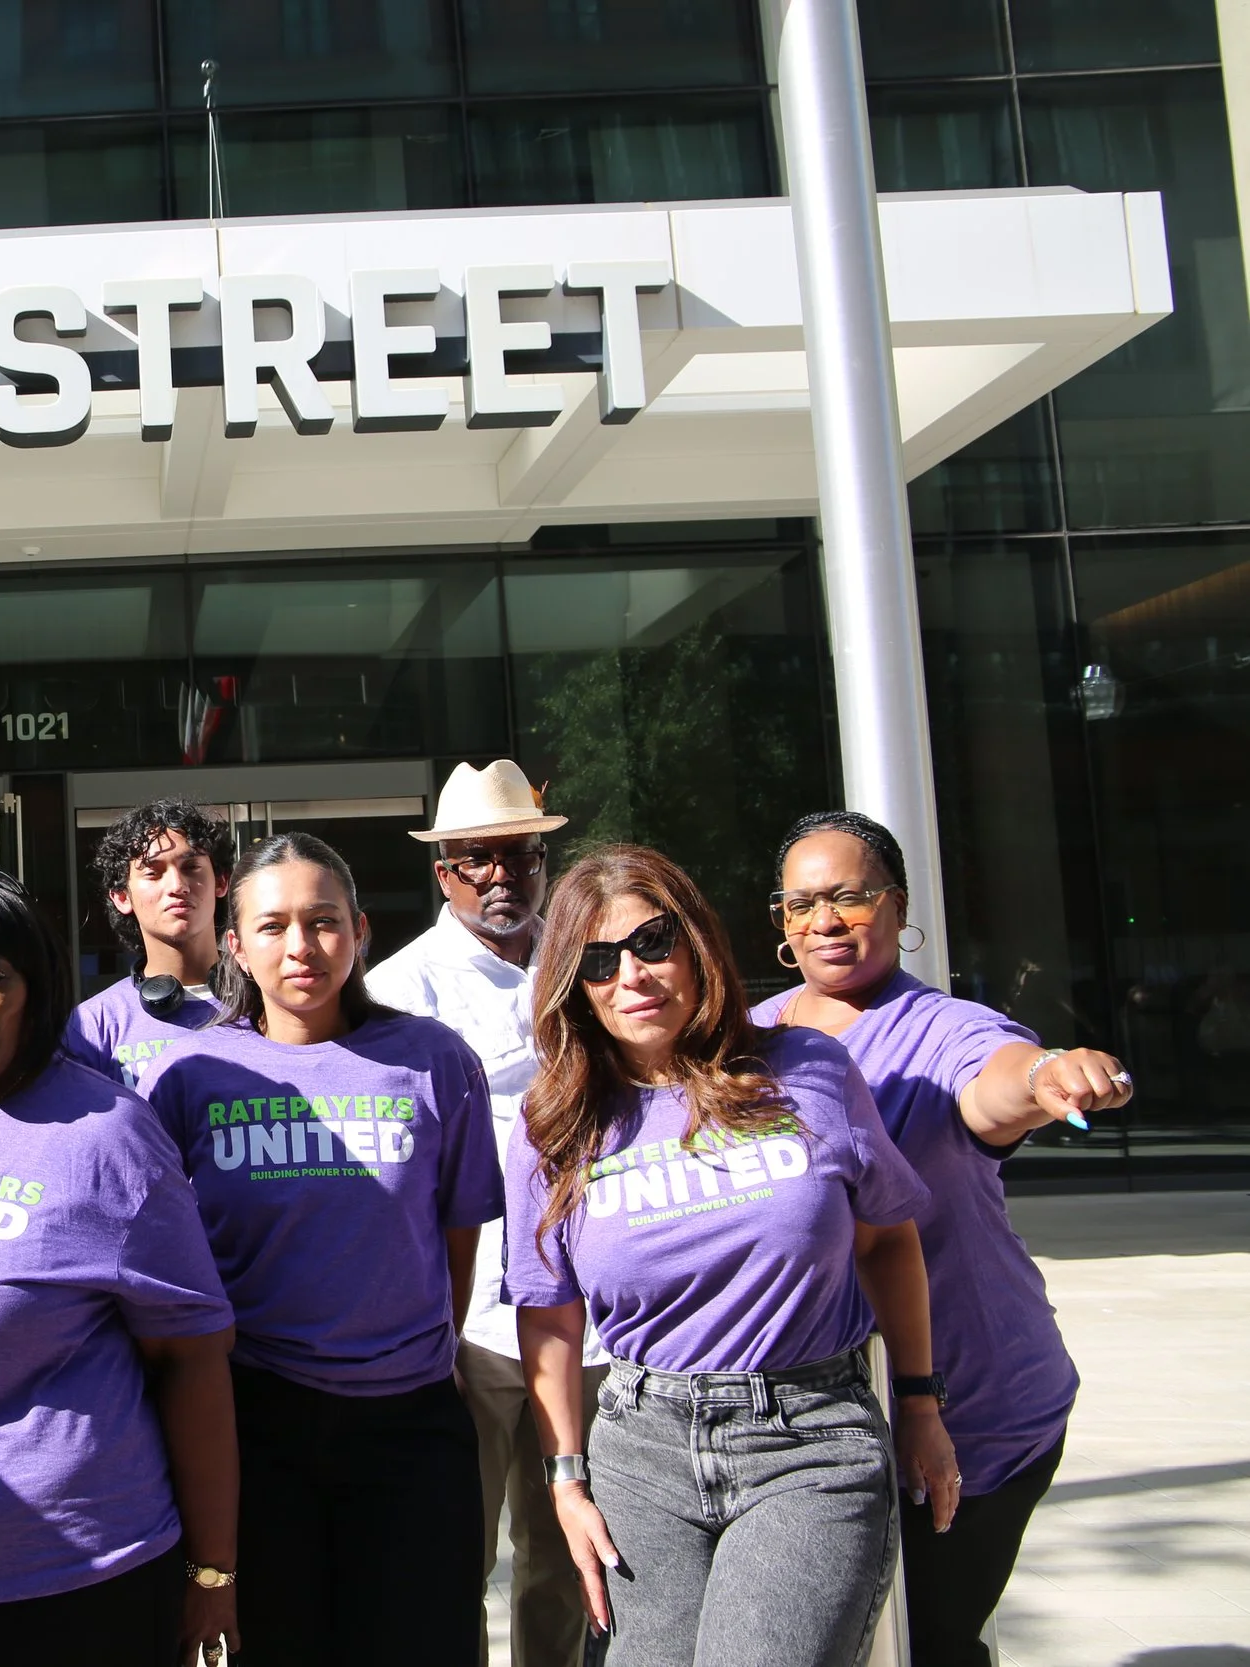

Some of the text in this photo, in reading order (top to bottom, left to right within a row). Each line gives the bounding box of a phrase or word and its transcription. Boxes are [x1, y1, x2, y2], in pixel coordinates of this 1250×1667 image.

[1, 712, 69, 741] 1021
[208, 1096, 415, 1127] RATEPAYERS
[211, 1120, 415, 1171] UNITED
[250, 1168, 380, 1181] BUILDING POWER TO WIN
[585, 1138, 809, 1219] UNITED
[627, 1188, 774, 1227] BUILDING POWER TO WIN
